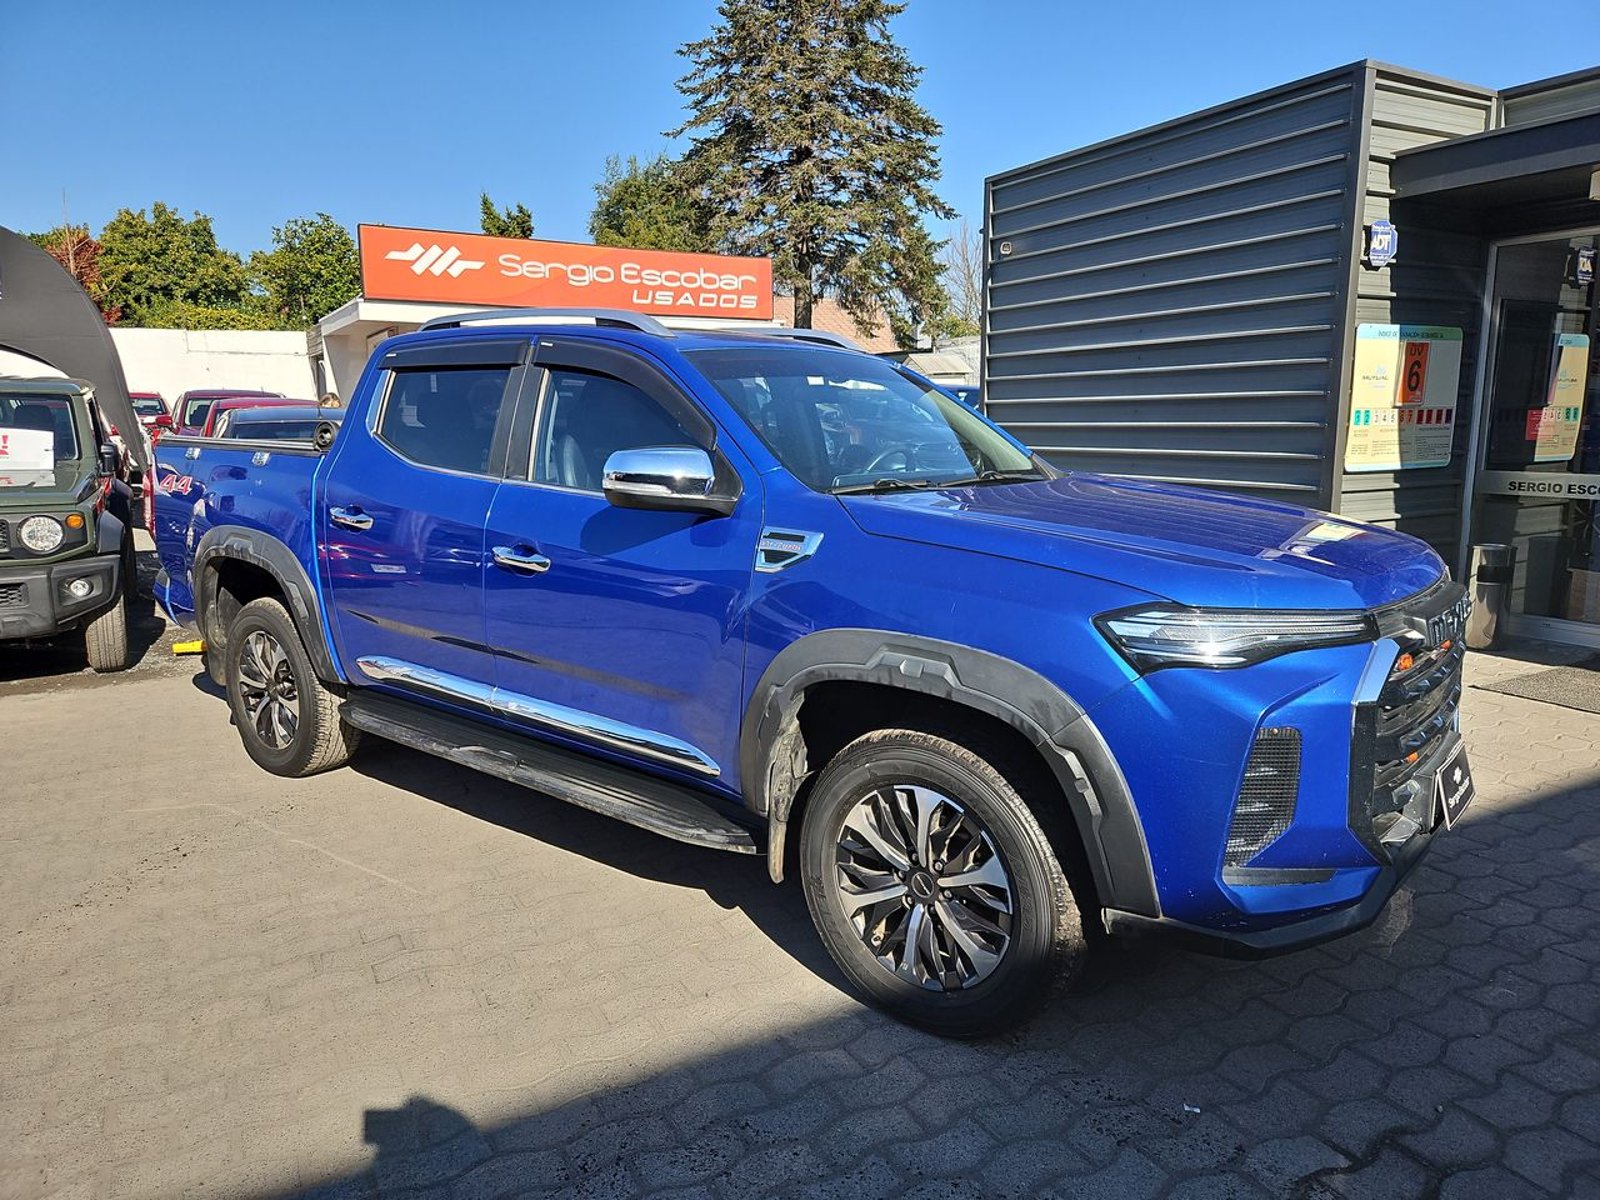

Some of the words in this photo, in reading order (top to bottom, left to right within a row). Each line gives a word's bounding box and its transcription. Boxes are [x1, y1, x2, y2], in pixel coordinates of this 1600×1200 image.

[1371, 235, 1390, 250] ADT
[498, 253, 614, 286] Sergio
[620, 262, 757, 290] Escobar
[632, 290, 757, 309] USADOS
[1410, 347, 1424, 356] UV
[1408, 360, 1422, 391] 6
[1508, 481, 1563, 493] SERGIO
